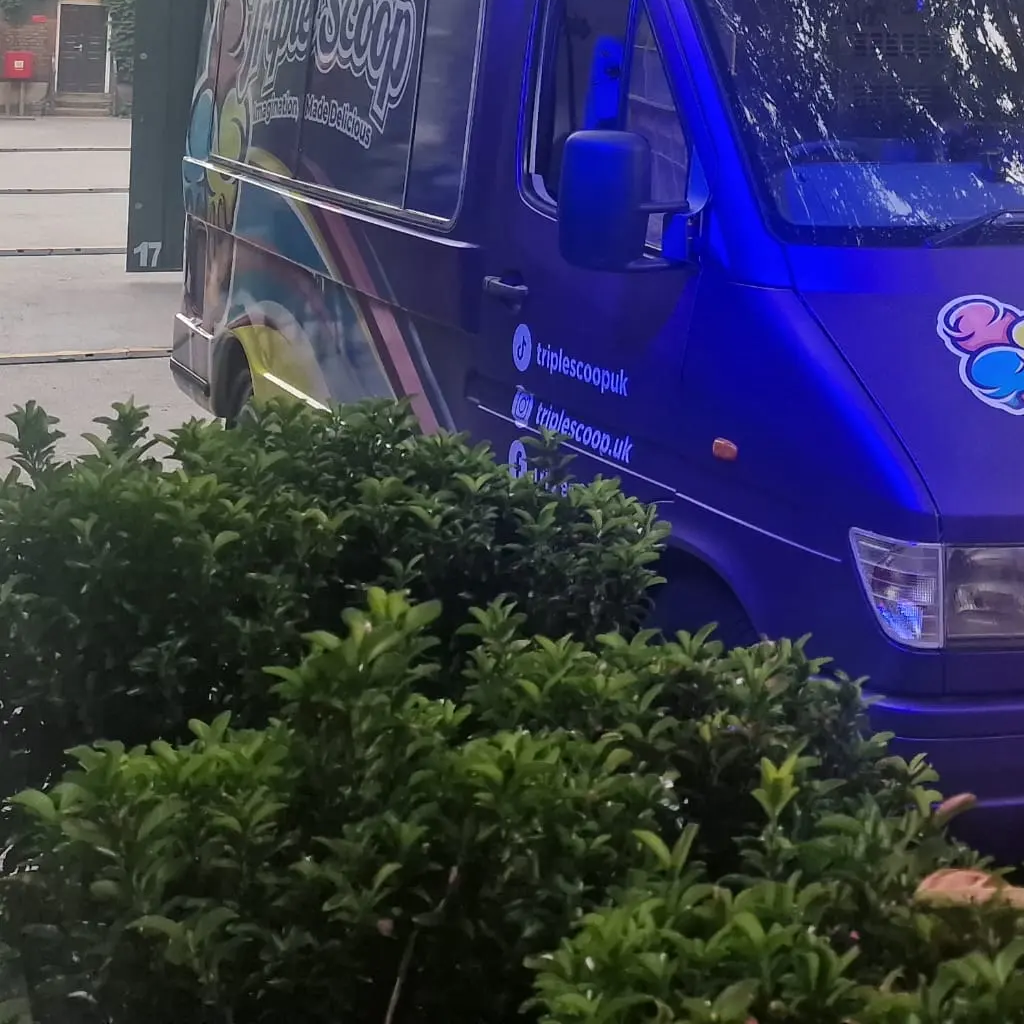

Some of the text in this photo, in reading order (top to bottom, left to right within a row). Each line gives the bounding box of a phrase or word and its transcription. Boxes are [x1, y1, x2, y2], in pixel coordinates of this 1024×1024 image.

[328, 99, 373, 149] Delicious
[133, 241, 162, 268] 17
[536, 342, 629, 397] triplescoopuk
[535, 402, 633, 464] triplescoop.uk
